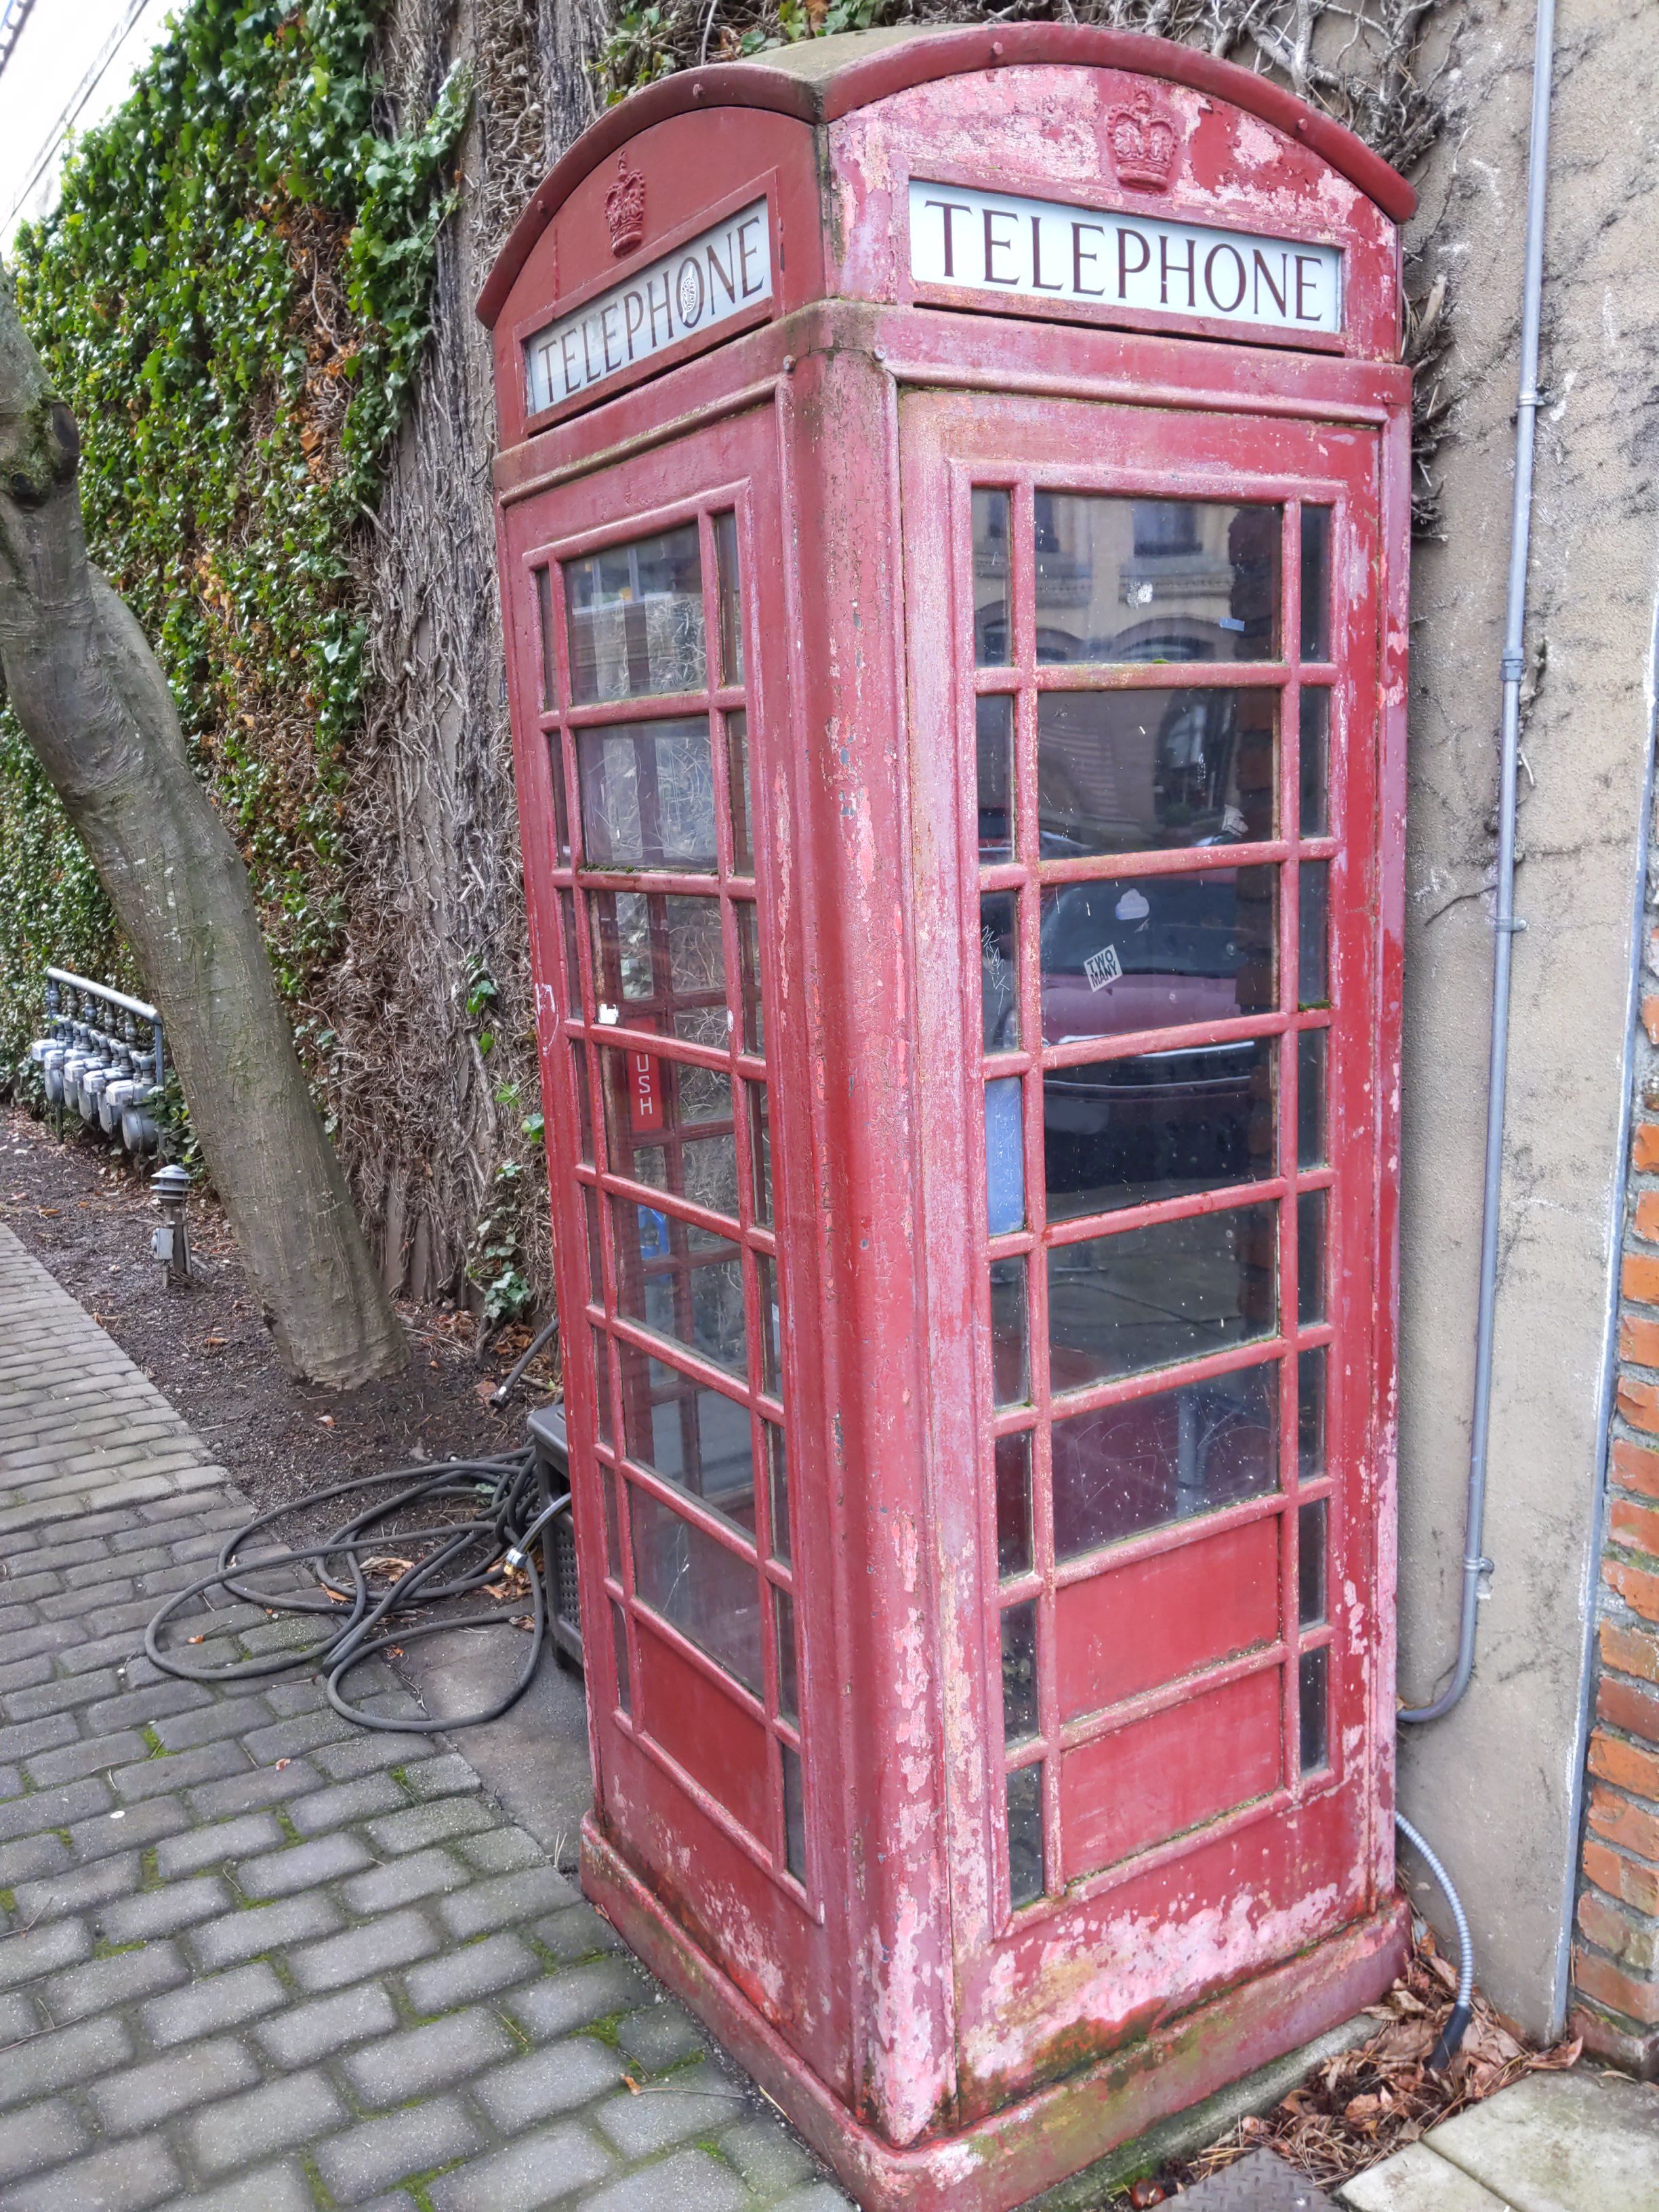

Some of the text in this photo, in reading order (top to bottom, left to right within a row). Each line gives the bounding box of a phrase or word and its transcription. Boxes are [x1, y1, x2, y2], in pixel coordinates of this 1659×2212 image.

[924, 200, 1323, 321] TELEPHONE
[538, 216, 764, 403] TELEPHONE
[1086, 949, 1113, 973] TWO
[1090, 960, 1117, 987] MANY
[636, 1053, 653, 1116] USH
